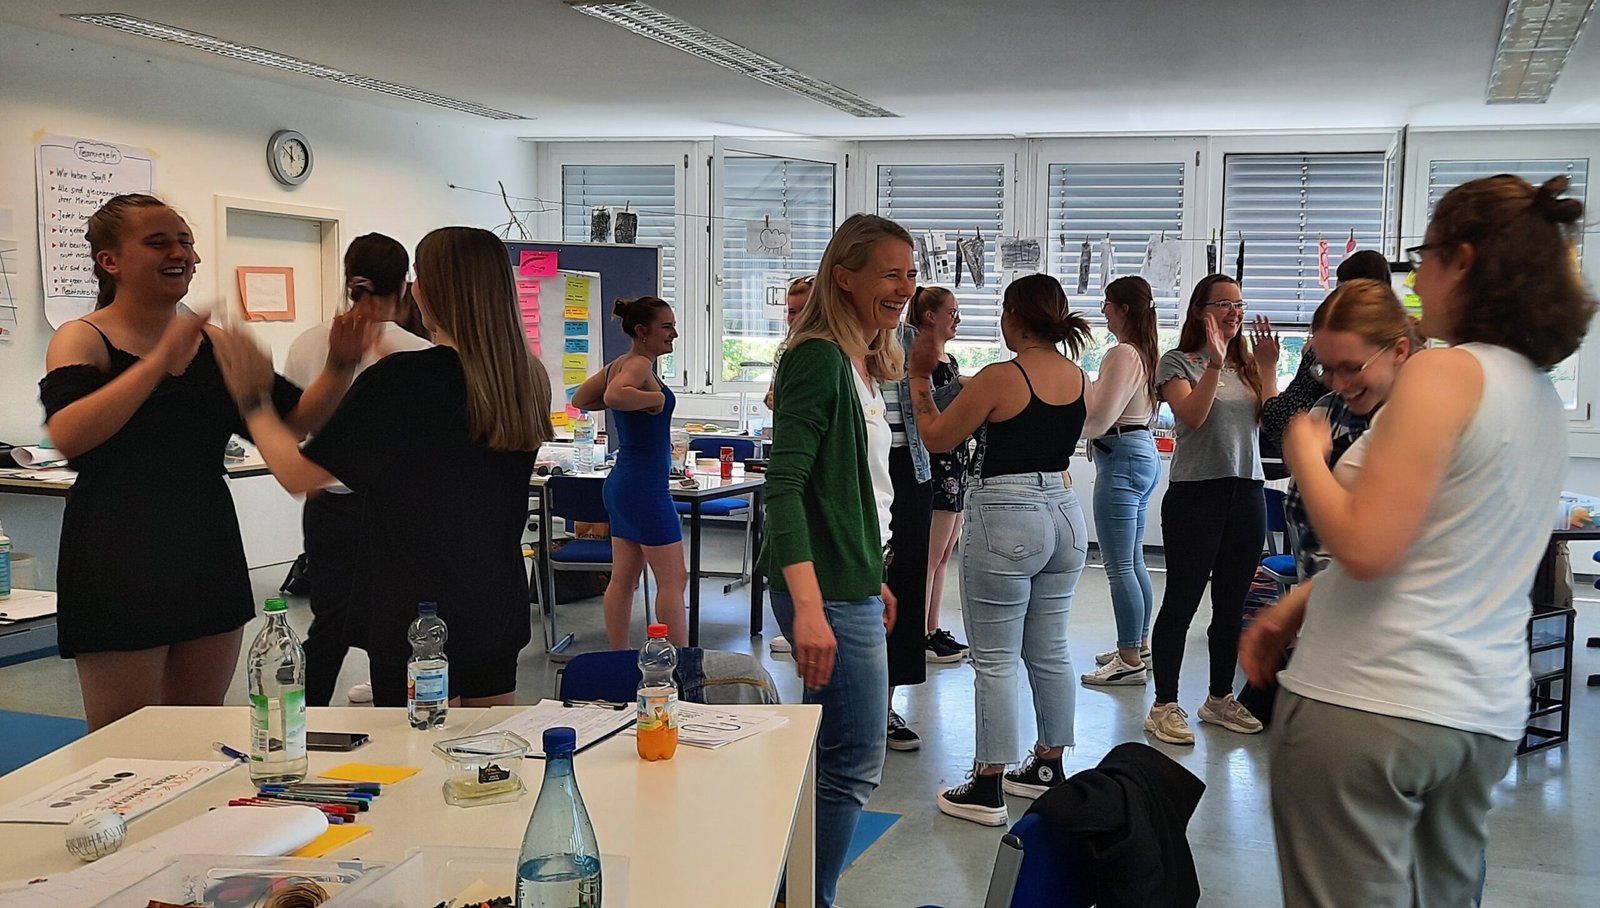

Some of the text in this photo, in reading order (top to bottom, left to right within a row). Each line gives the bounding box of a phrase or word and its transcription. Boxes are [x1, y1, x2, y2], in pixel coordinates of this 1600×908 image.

[78, 146, 117, 161] Teamregeln
[56, 168, 68, 177] Wir
[70, 169, 87, 180] haben
[59, 224, 68, 234] Wir
